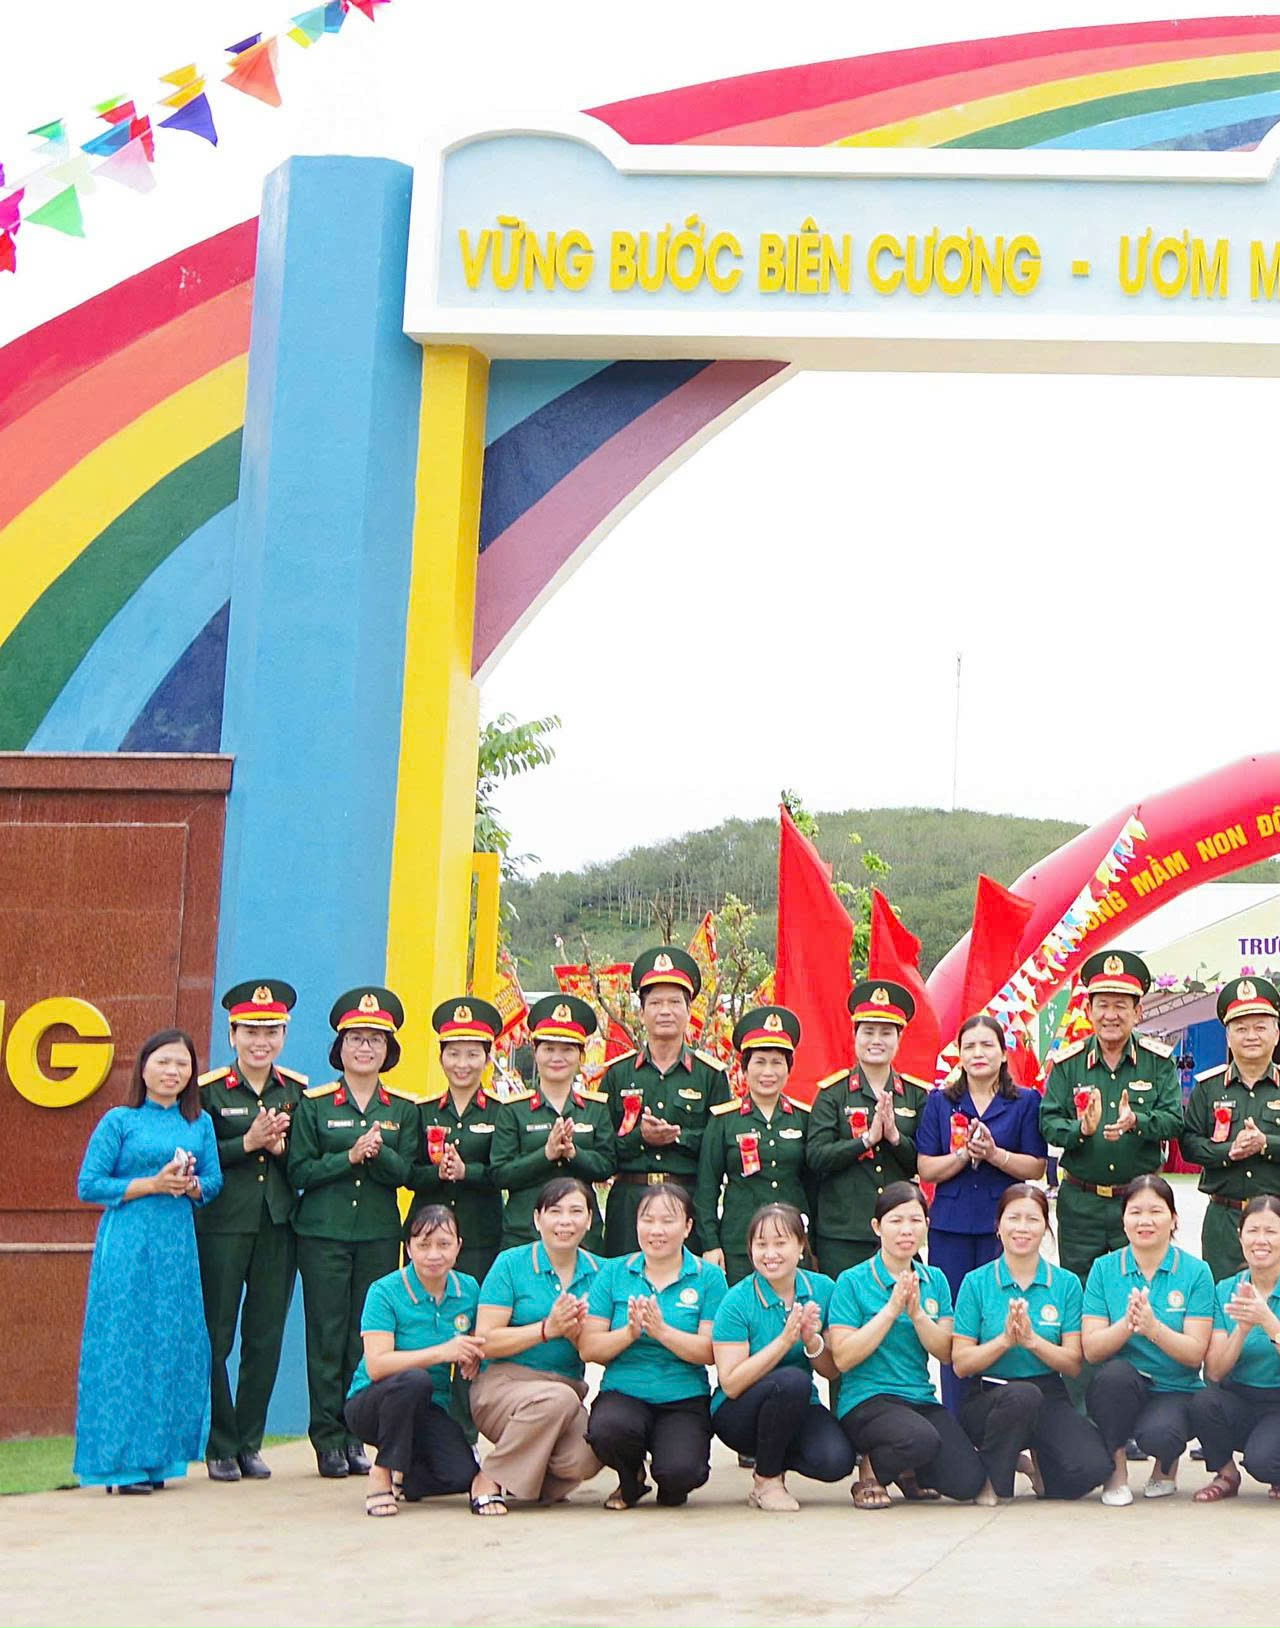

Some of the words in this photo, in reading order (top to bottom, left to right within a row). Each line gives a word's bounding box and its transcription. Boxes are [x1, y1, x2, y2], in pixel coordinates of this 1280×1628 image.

[458, 214, 595, 291] VỮNG
[609, 213, 743, 293] BƯỚC
[757, 216, 853, 294] BIÊN
[866, 226, 1043, 297] CƯƠNG
[1118, 226, 1230, 299] ƯƠM
[1195, 824, 1248, 862] NON
[0, 996, 115, 1108] G
